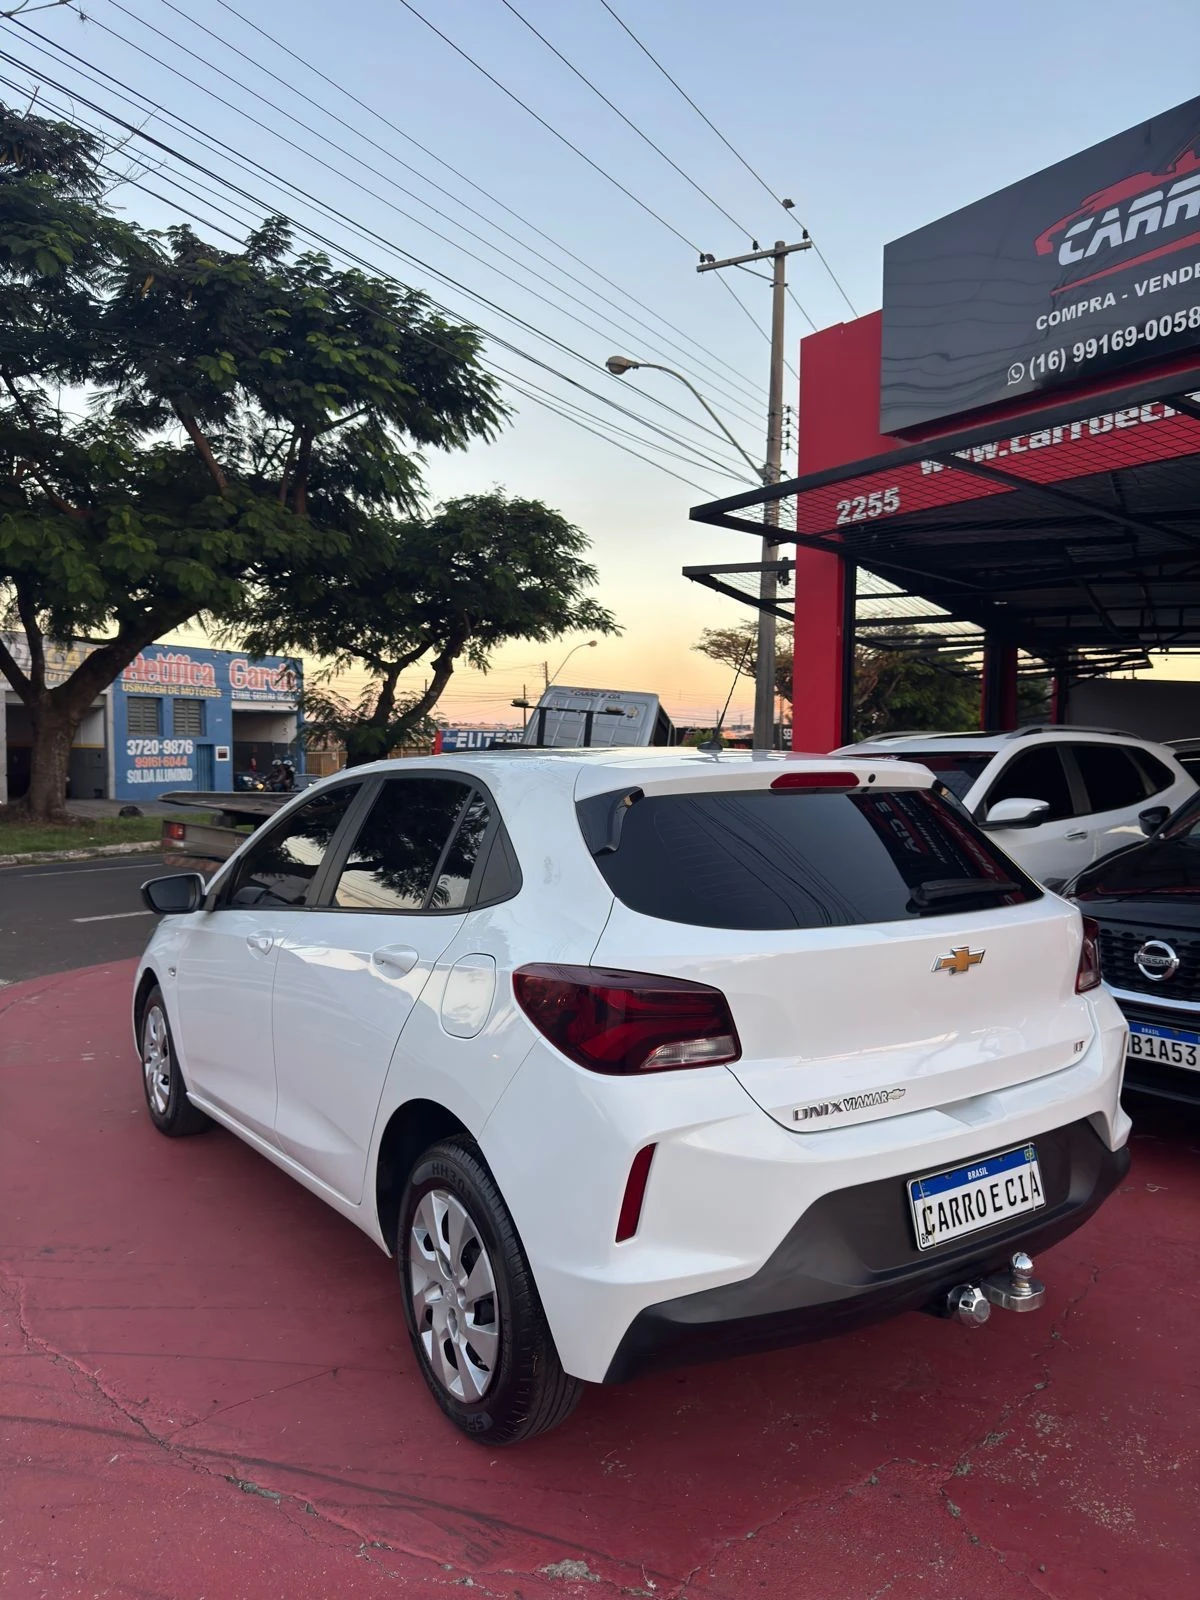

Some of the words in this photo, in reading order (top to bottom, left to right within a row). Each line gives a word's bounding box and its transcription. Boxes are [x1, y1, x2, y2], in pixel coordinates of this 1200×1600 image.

[1036, 291, 1116, 330] COMPRA
[1029, 347, 1066, 381] (16)
[1072, 305, 1200, 363] 99169-0058
[836, 487, 900, 525] 2255
[1136, 954, 1174, 966] NISSAN
[1127, 1034, 1197, 1066] B1A53
[793, 1101, 843, 1121] ONIX
[842, 1090, 889, 1112] VIAMAR
[967, 1166, 988, 1180] BRASIL
